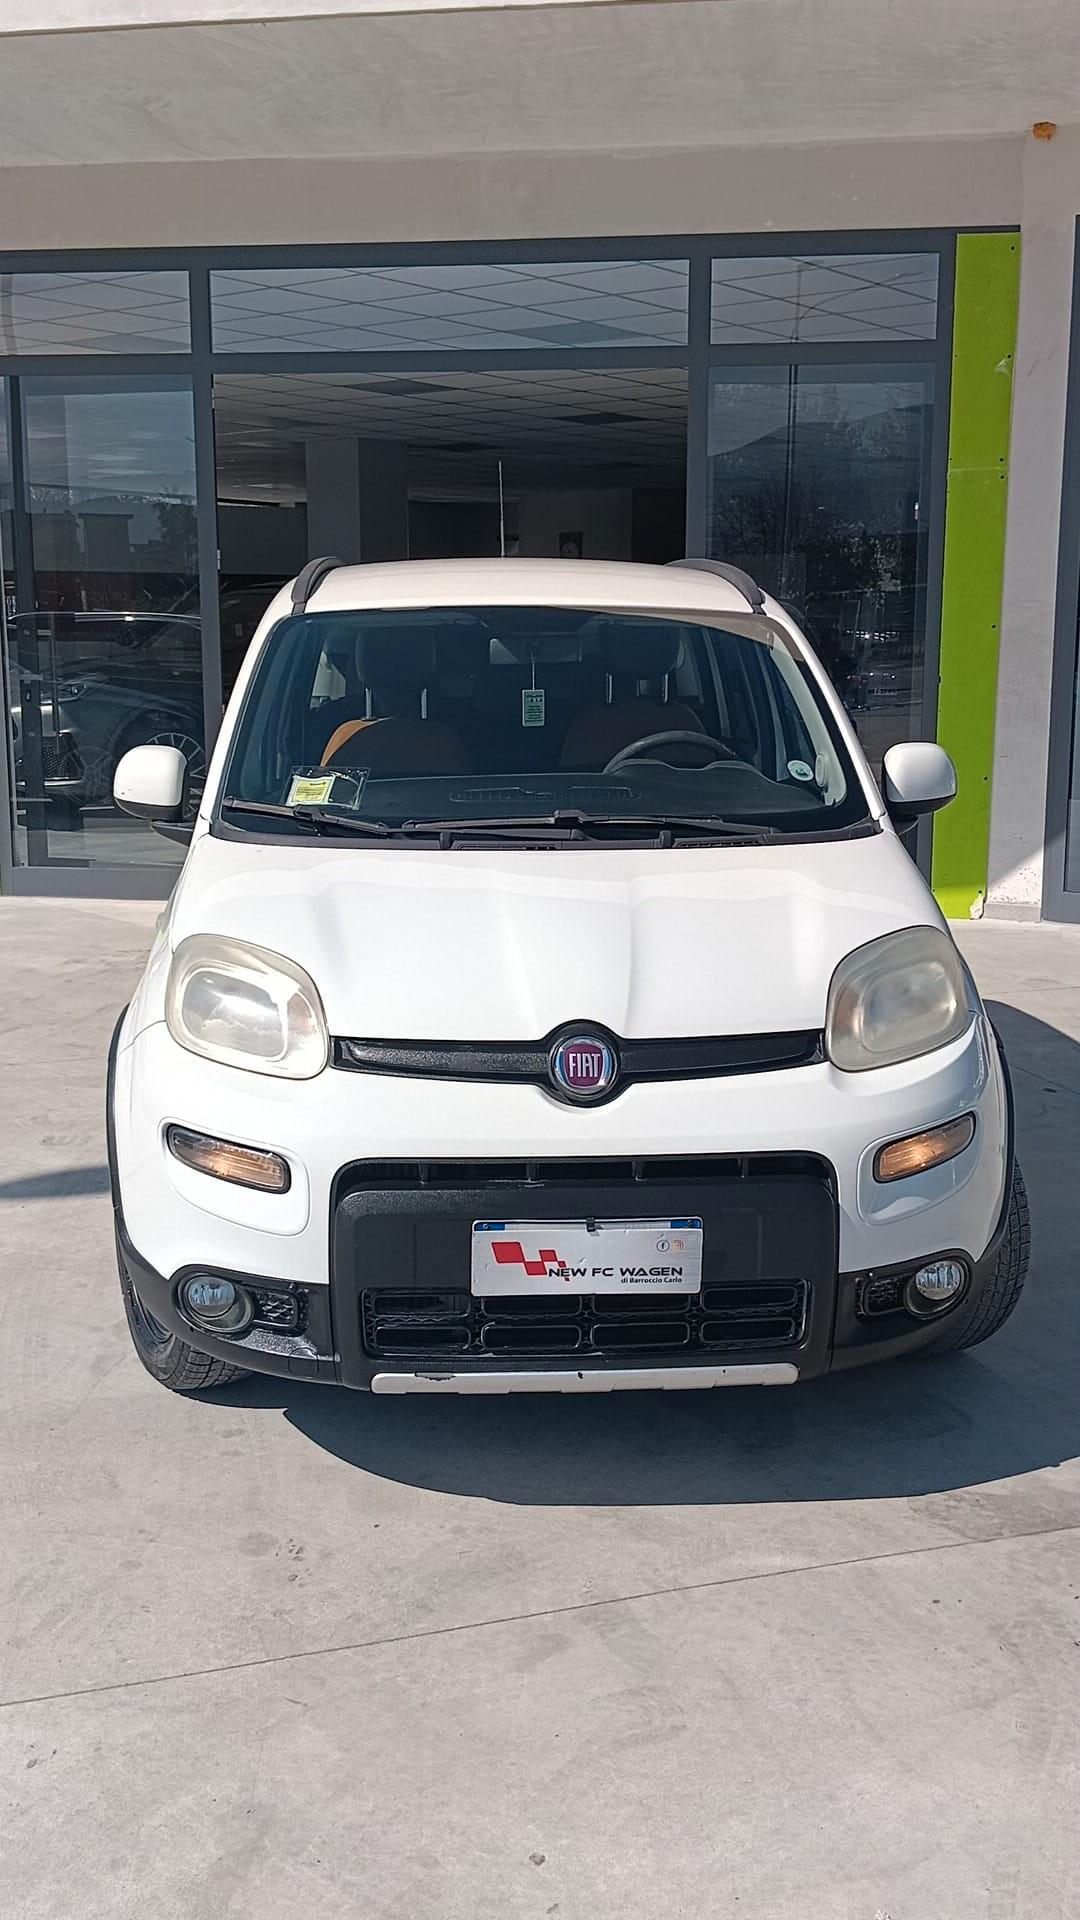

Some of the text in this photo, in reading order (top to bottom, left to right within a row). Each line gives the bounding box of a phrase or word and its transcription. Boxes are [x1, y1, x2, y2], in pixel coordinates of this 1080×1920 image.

[568, 1053, 601, 1078] FIAT
[548, 1267, 683, 1278] NEW FC WAGEN
[663, 1276, 683, 1284] Carlo
